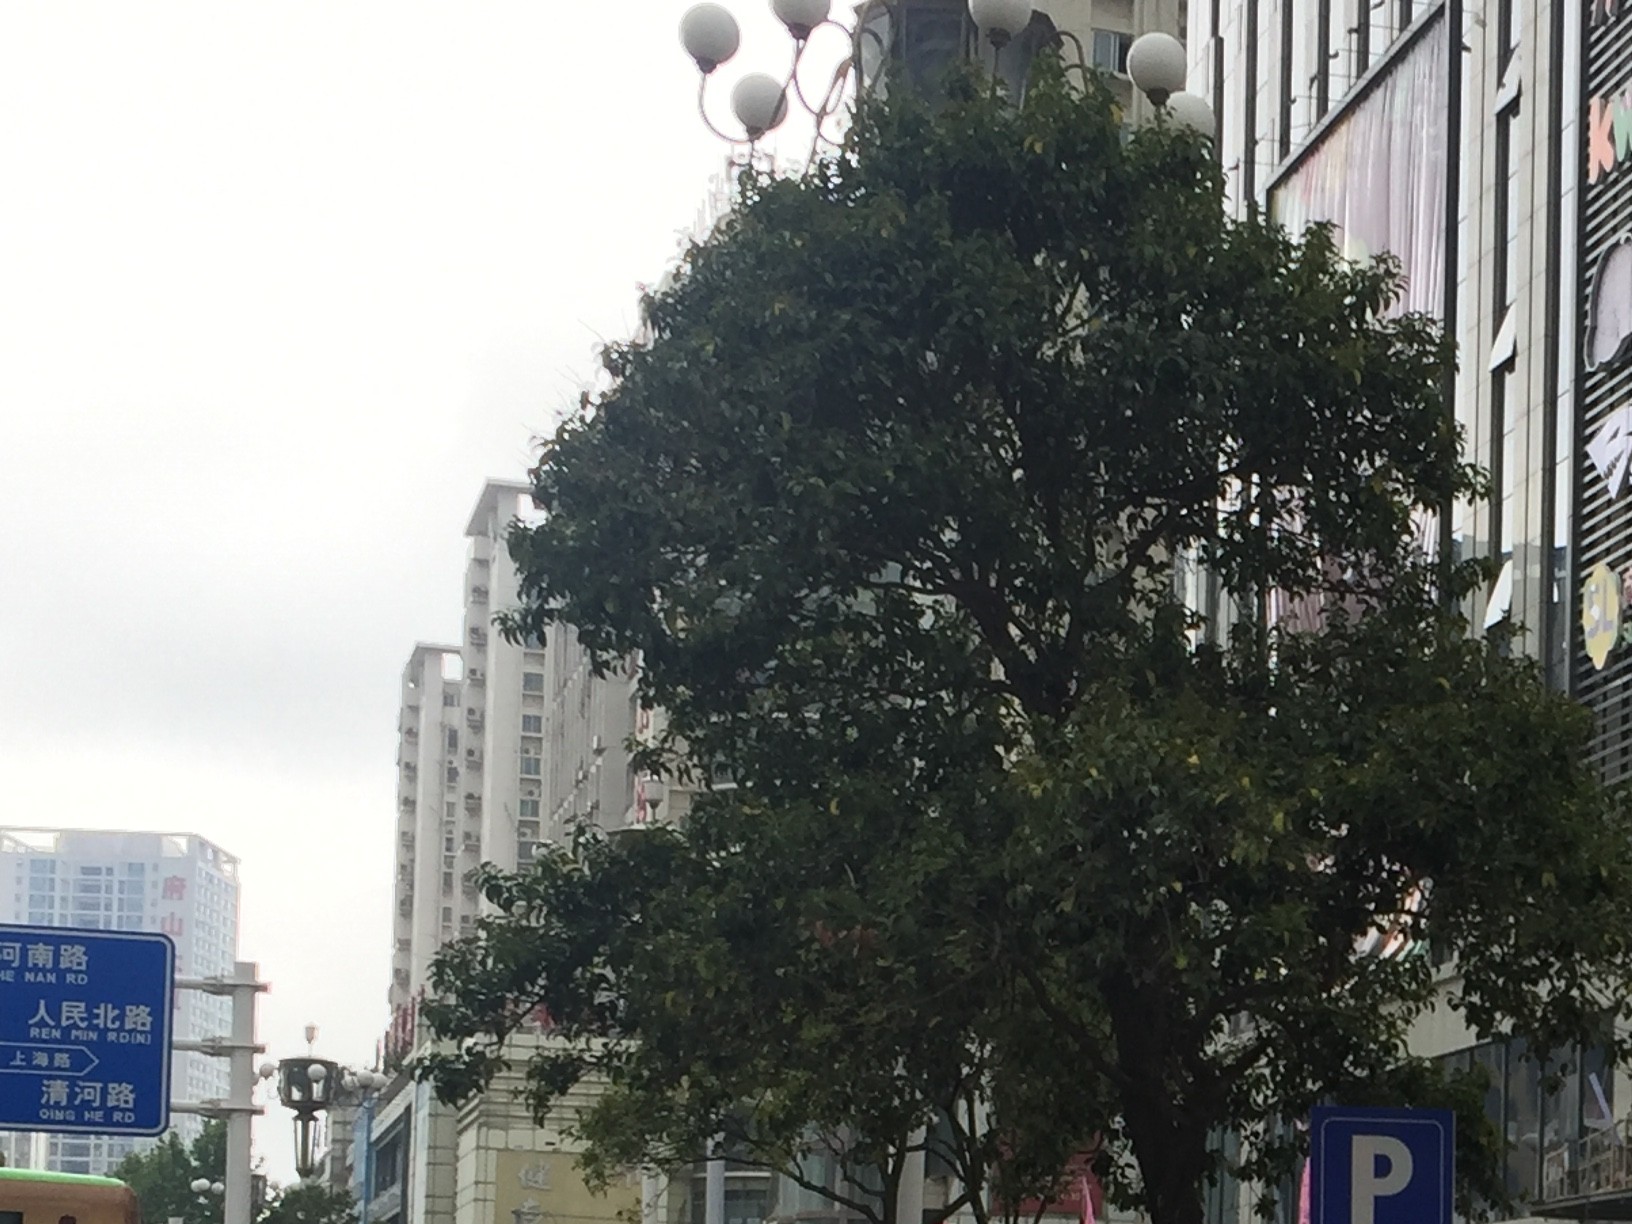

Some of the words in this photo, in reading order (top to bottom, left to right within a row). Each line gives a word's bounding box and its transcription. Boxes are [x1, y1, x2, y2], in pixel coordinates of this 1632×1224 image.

[24, 971, 56, 983] NAN
[66, 973, 88, 985] RD
[28, 999, 152, 1031] 人民北路
[30, 1027, 61, 1039] REN
[71, 1029, 98, 1041] MIN
[10, 1050, 70, 1068] 上海路
[41, 1079, 136, 1109] 清河路
[40, 1108, 75, 1121] QING
[84, 1110, 104, 1122] HE
[112, 1111, 135, 1123] RD
